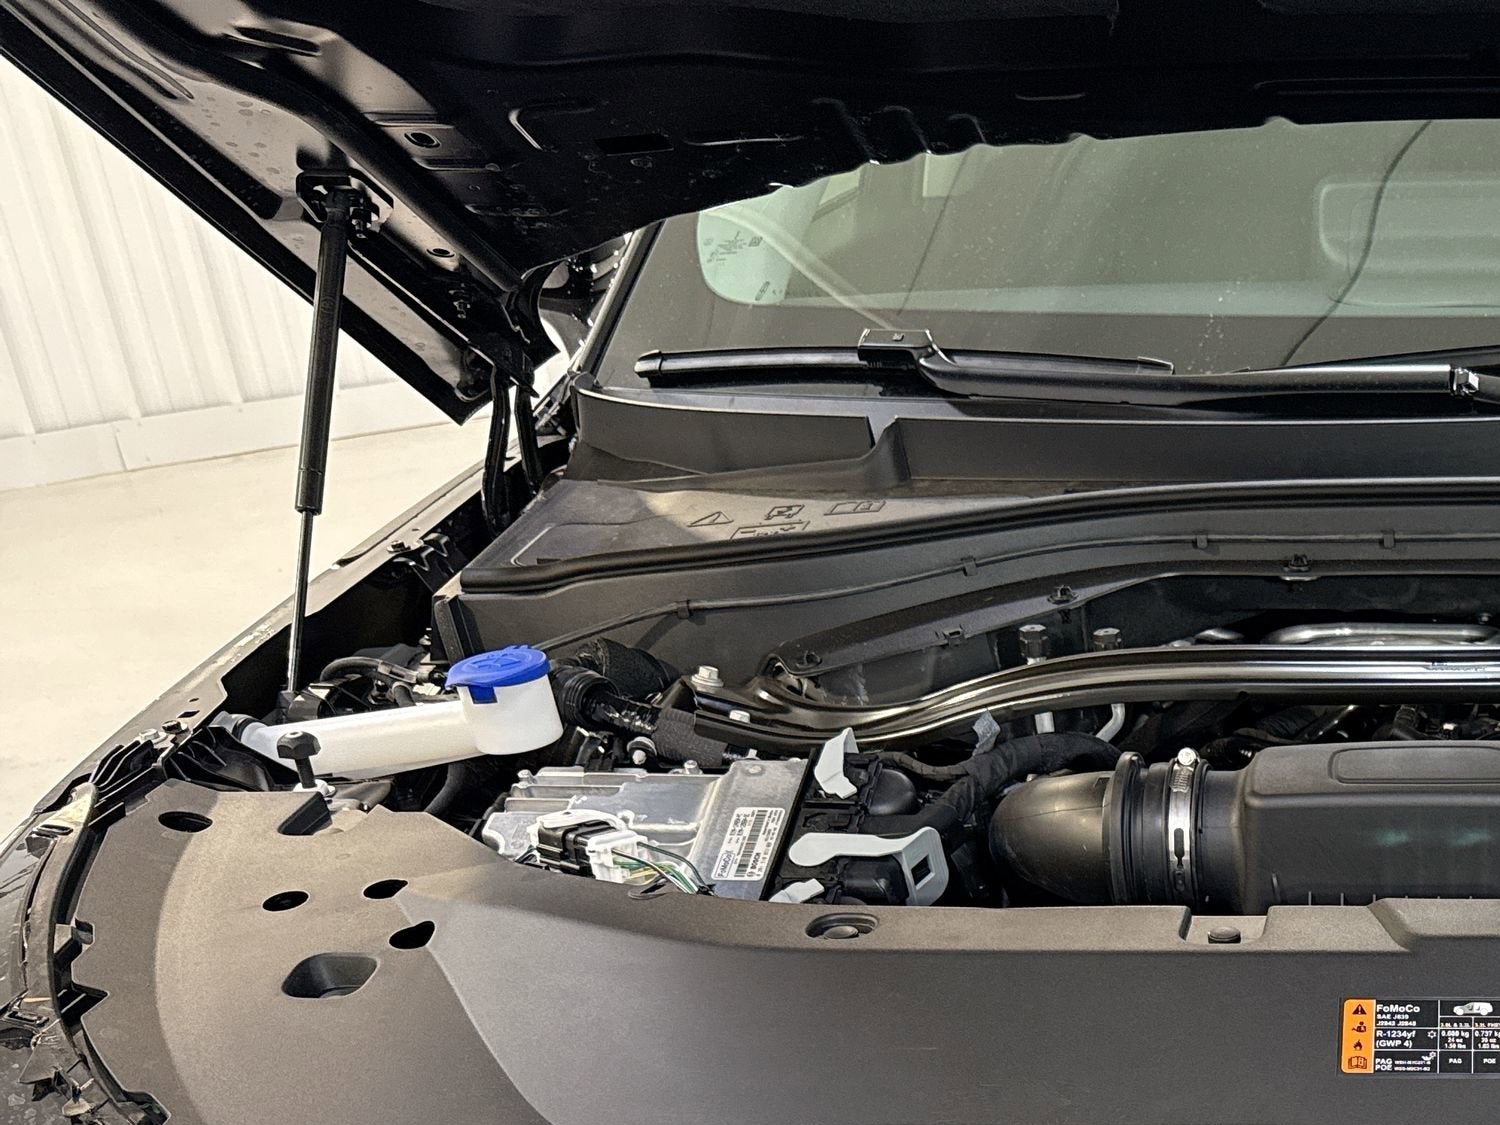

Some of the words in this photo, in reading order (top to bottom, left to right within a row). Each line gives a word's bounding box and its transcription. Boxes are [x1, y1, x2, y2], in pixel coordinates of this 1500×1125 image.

[1376, 1004, 1420, 1012] FoMoCo
[1376, 1030, 1416, 1039] R-1234yf
[1460, 1030, 1470, 1038] kg
[1376, 1040, 1402, 1048] (GWP
[1403, 1040, 1413, 1048] 4)
